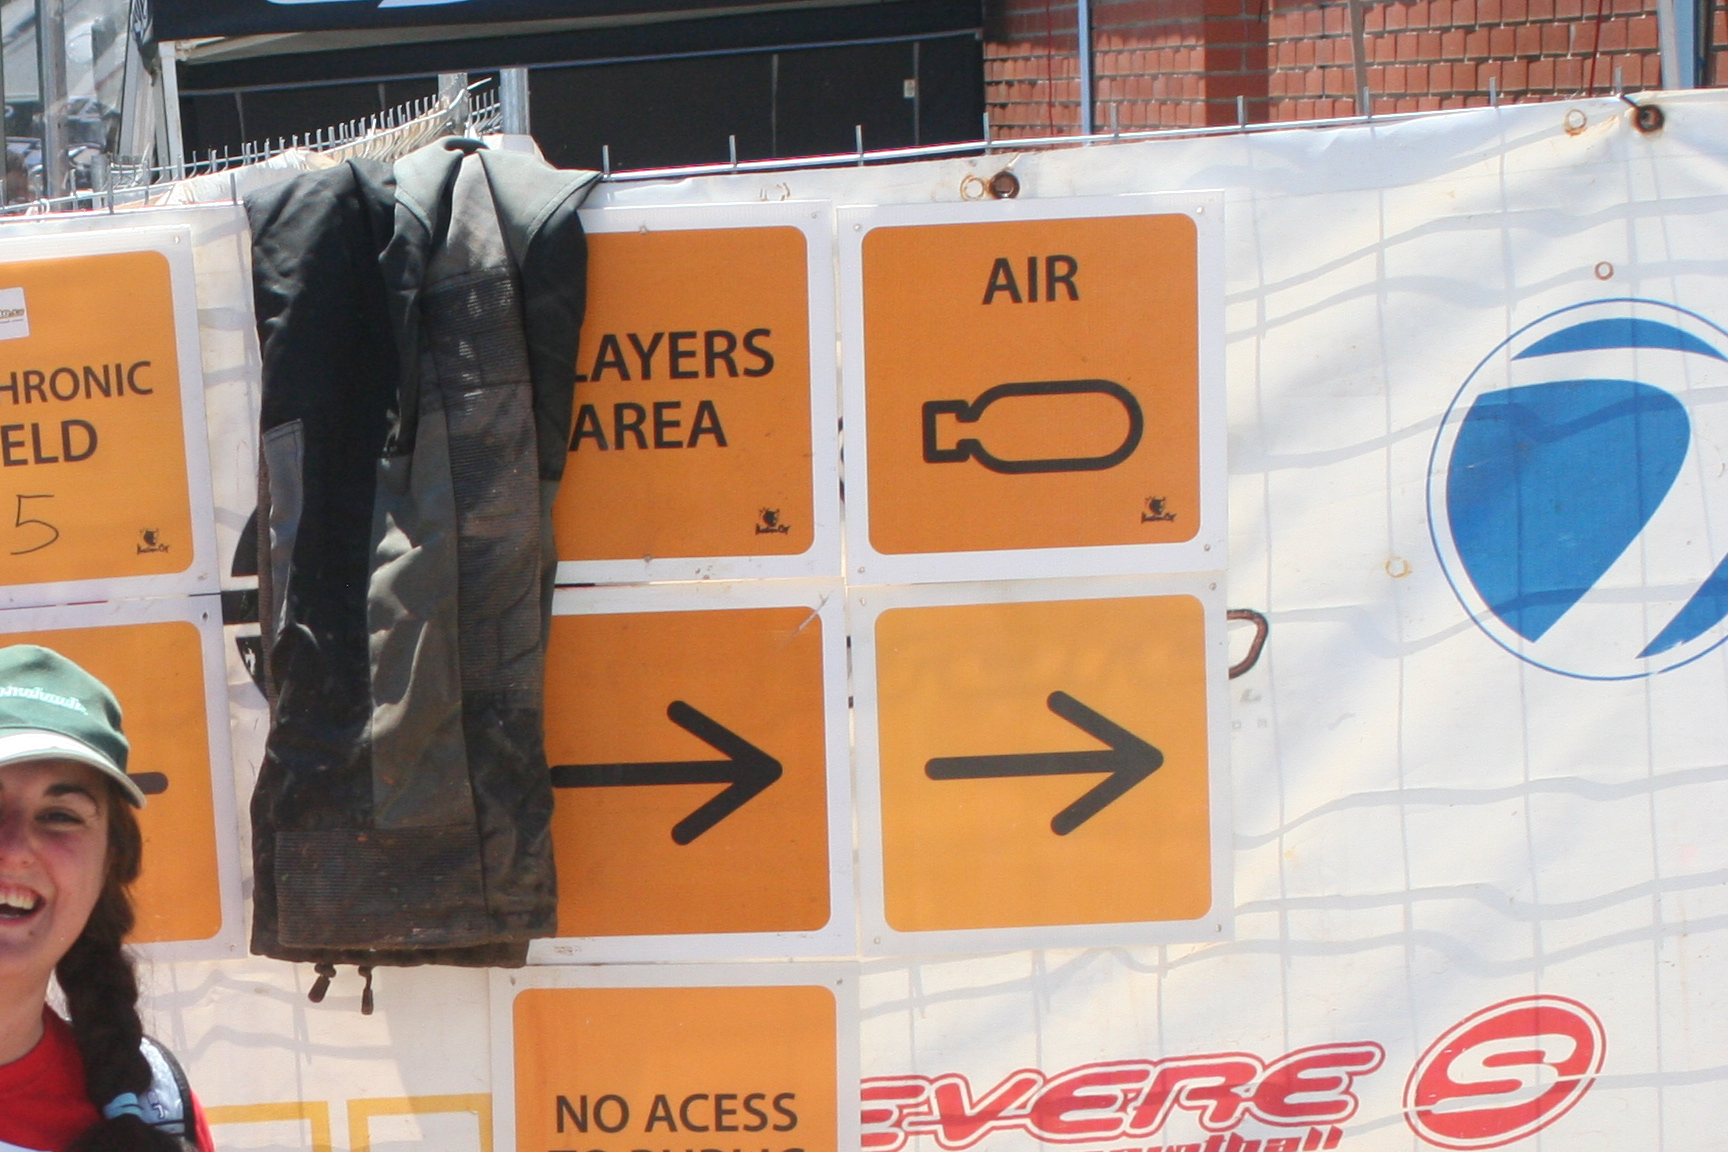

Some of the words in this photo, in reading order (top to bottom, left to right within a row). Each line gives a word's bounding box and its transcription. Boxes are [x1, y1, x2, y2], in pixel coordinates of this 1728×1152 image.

[981, 254, 1080, 305] AIR
[575, 328, 775, 383] AYERS
[568, 400, 728, 451] AREA
[9, 493, 60, 556] 5
[554, 1094, 630, 1134] NO
[645, 1092, 798, 1133] ACESS
